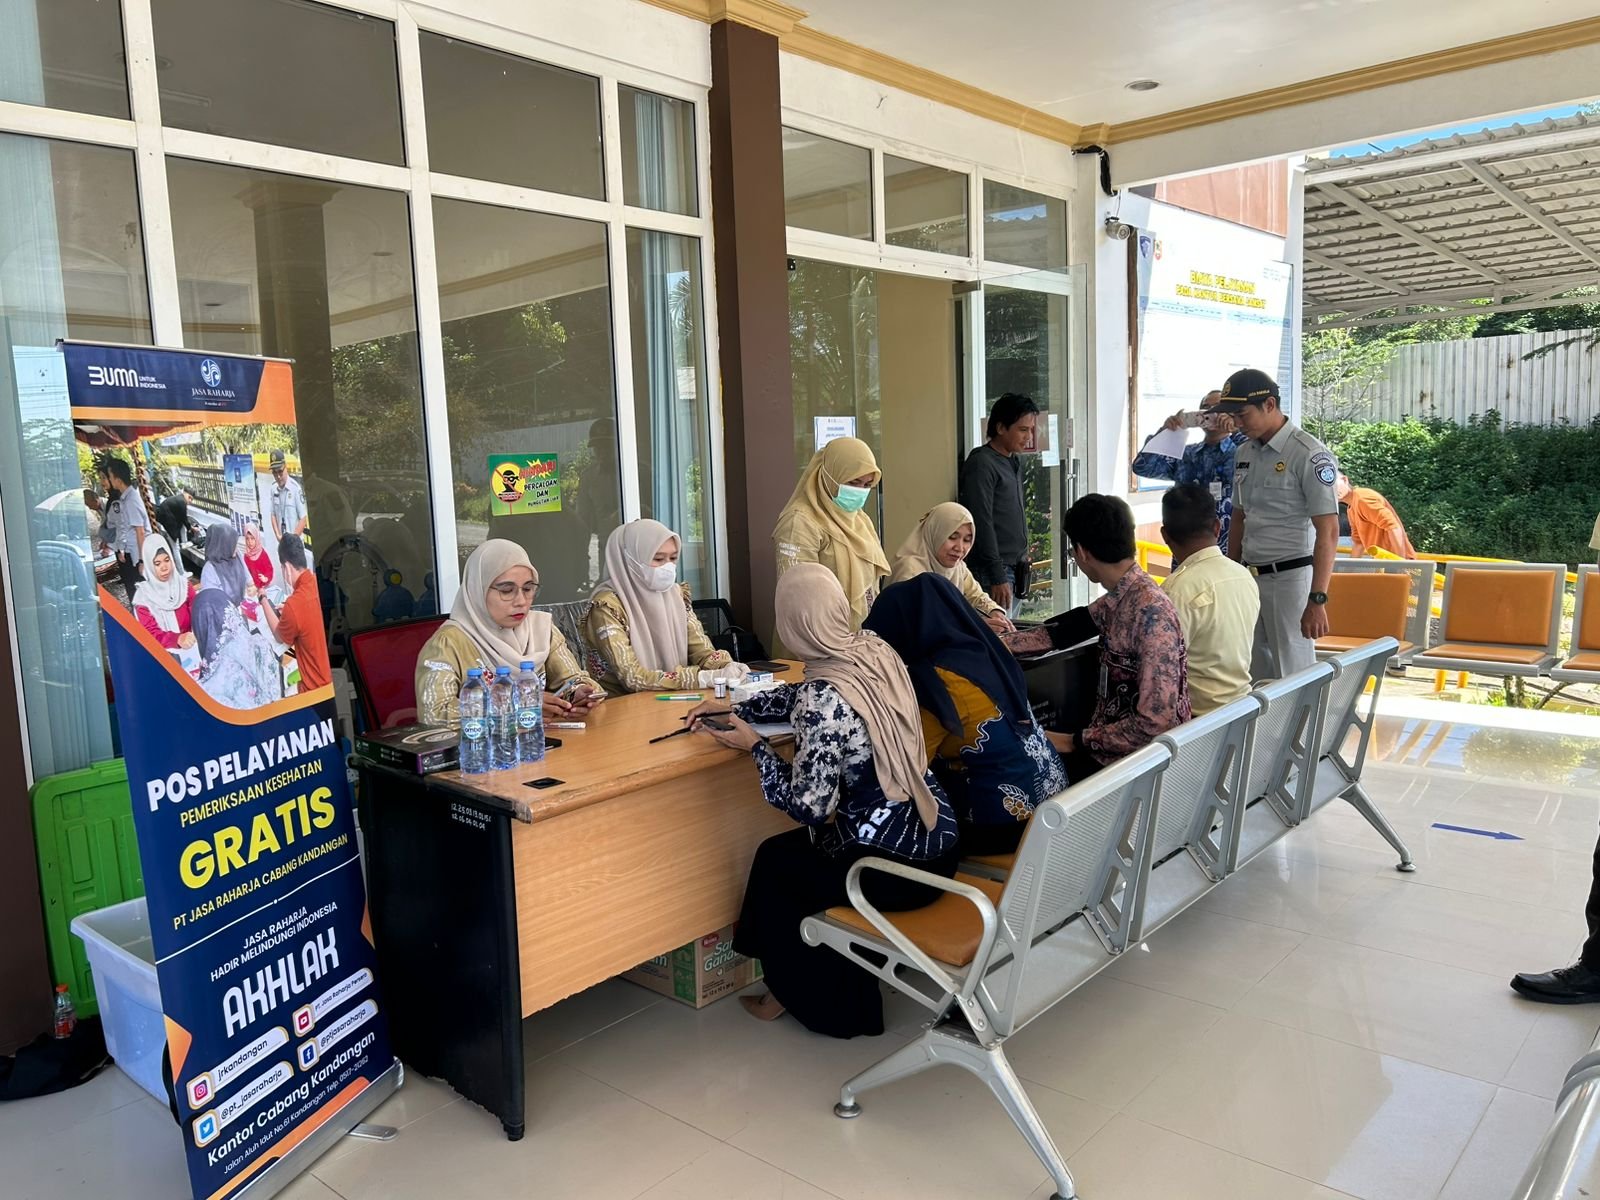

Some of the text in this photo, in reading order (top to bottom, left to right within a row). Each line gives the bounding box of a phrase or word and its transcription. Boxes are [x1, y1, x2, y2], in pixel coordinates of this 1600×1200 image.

[88, 366, 139, 387] BUMN
[192, 387, 236, 398] JASA RAHARJA
[537, 490, 549, 498] DAN
[147, 718, 335, 812] POS PELAYANAN
[180, 759, 323, 828] PEMERIKSAAN KESEHATAN
[179, 787, 335, 889] GRATIS
[173, 833, 348, 930] PT JASA RAHARJA CABANG KANDANGAN
[210, 901, 338, 982] HADIR MELINDUNGI INDONESIA
[243, 906, 308, 949] JASA RAHARJA
[222, 926, 340, 1038] AKHLAK
[322, 996, 332, 1006] Jasa
[332, 983, 351, 998] Raharja
[321, 1008, 366, 1047] @ptjasaraharja
[217, 1039, 268, 1082] jrkandangan
[207, 1031, 375, 1167] Kantor Cabang Kandangan
[221, 1067, 283, 1120] @pt_jasaraharja
[224, 1156, 244, 1174] Jalan
[244, 1142, 259, 1158] Aluh
[259, 1131, 274, 1148] Idut
[290, 1091, 326, 1122] Kandangan
